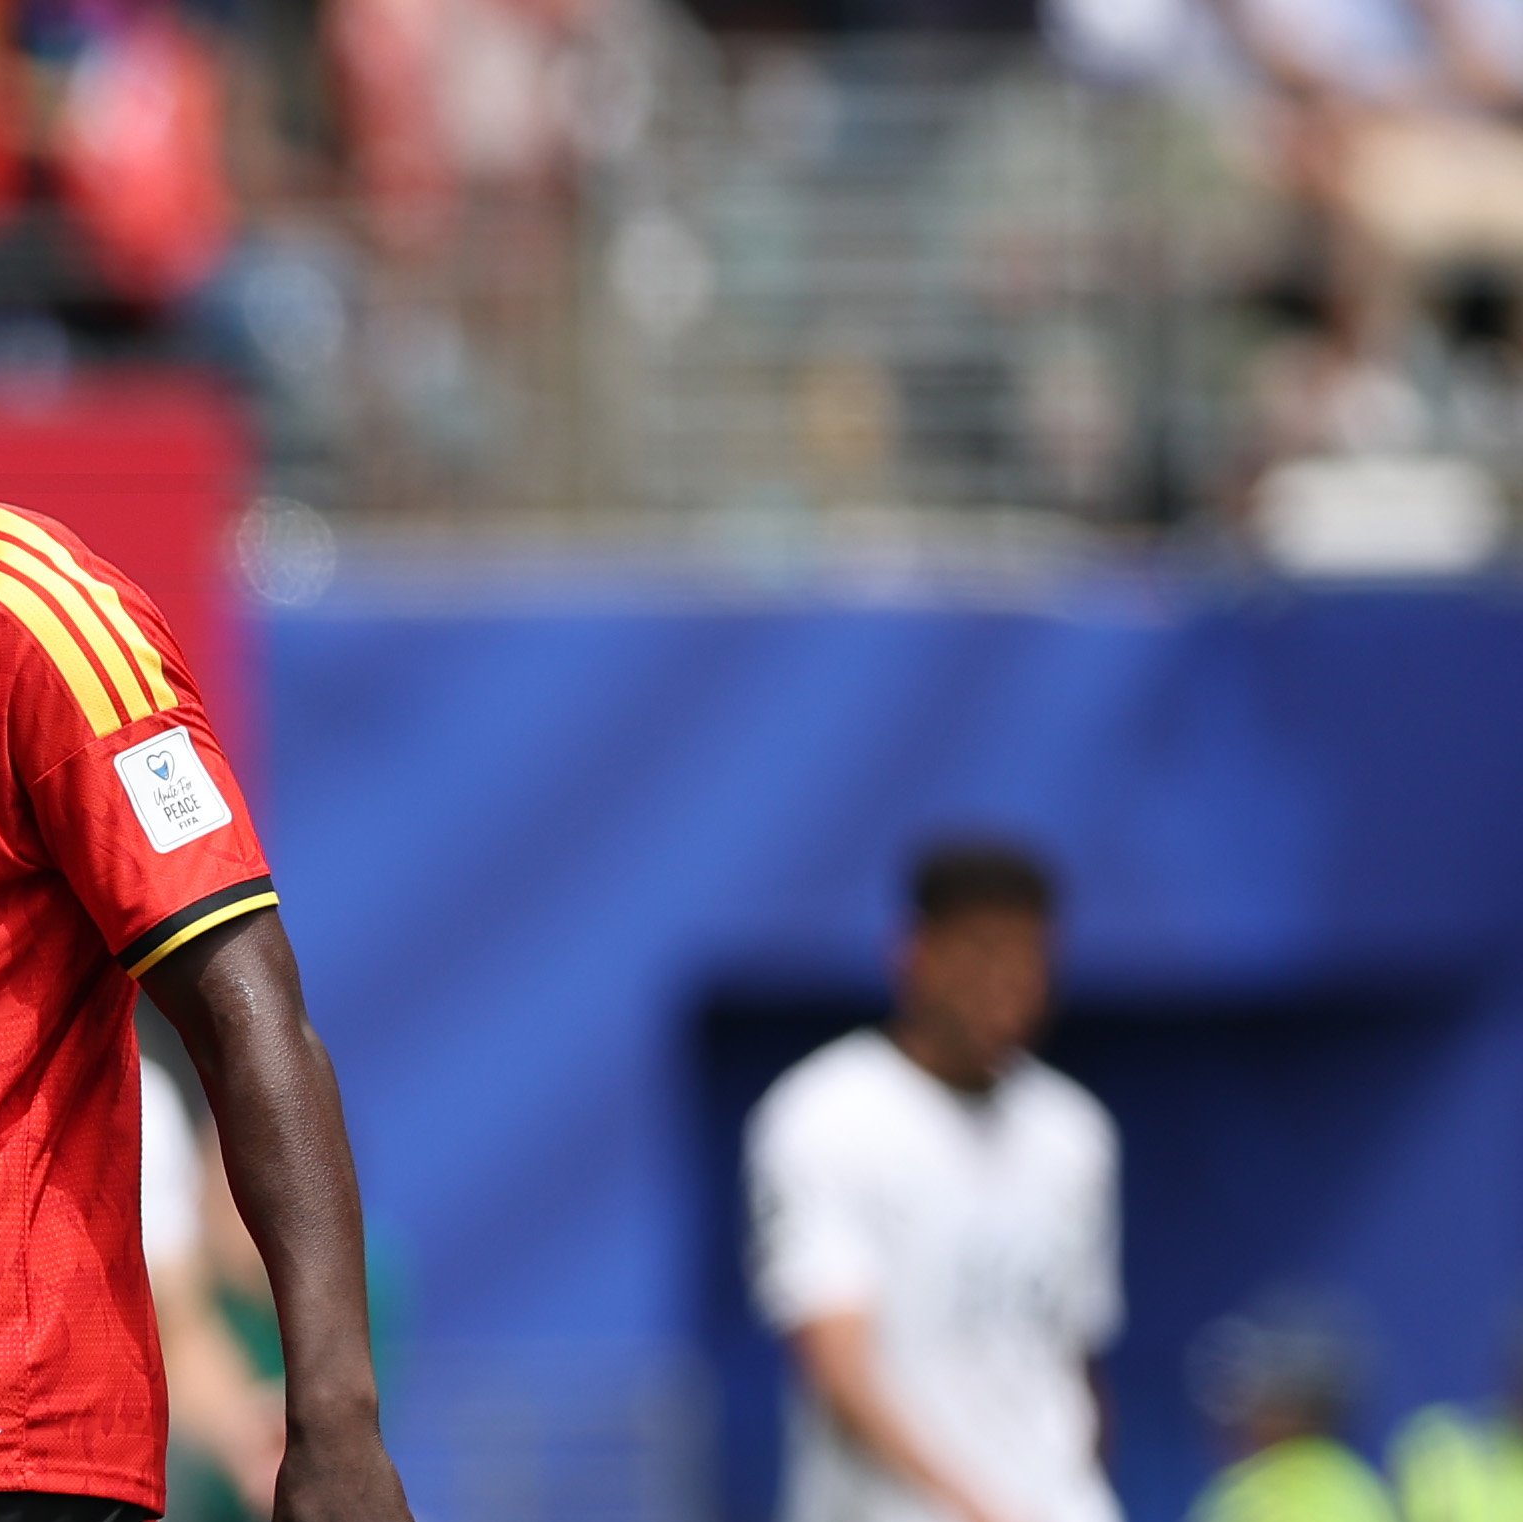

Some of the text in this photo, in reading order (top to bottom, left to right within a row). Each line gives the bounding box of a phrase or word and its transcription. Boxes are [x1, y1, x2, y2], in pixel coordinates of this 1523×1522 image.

[153, 776, 193, 807] Unite For
[163, 794, 201, 823] PEACE
[178, 816, 200, 830] FIFA
